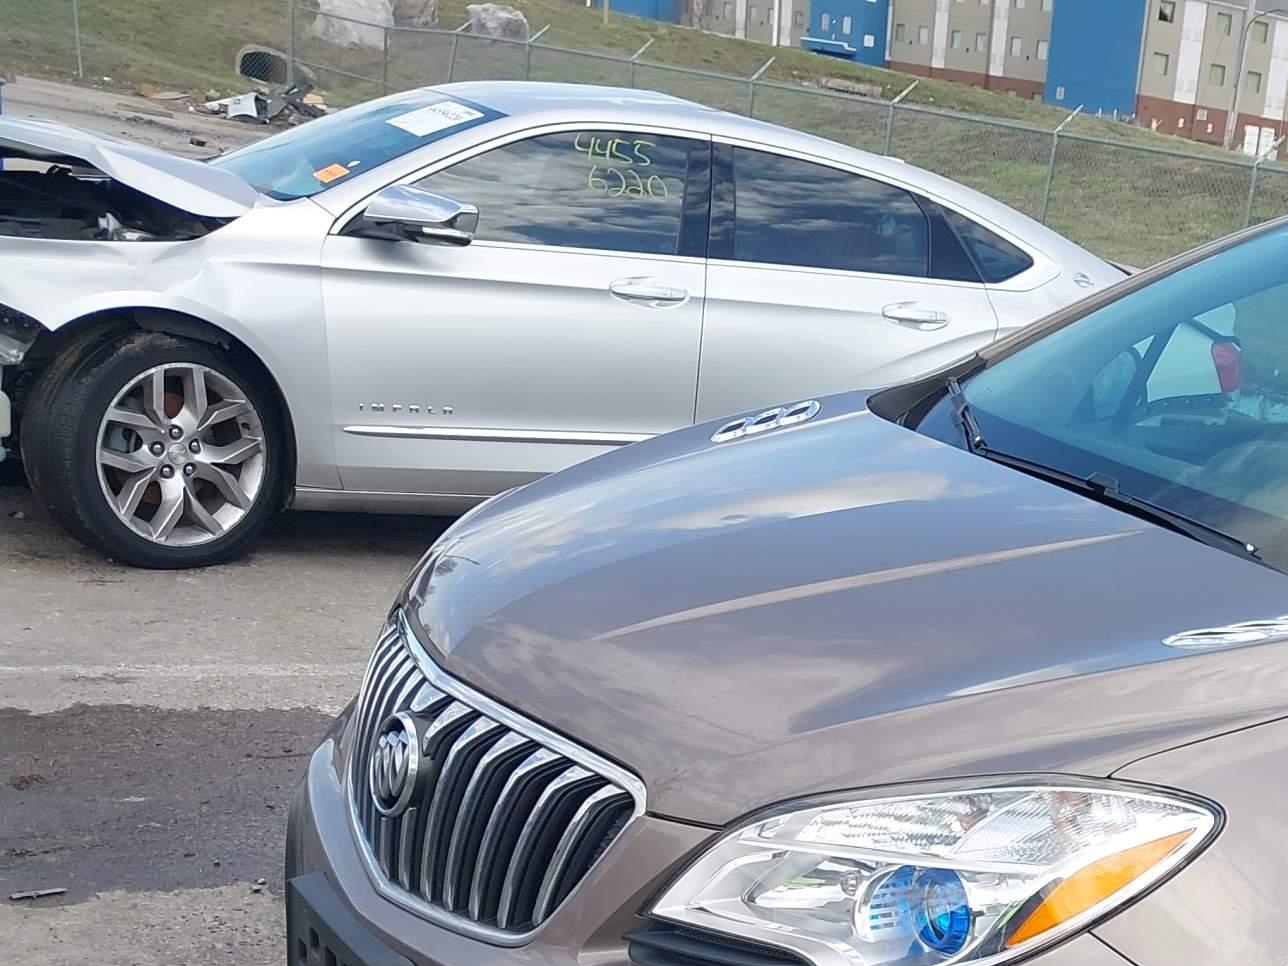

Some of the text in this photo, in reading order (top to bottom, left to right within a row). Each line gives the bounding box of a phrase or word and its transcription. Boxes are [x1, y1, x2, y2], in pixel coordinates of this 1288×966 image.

[574, 132, 657, 167] 4455
[587, 164, 669, 202] 6220
[359, 402, 455, 416] IMPALA
